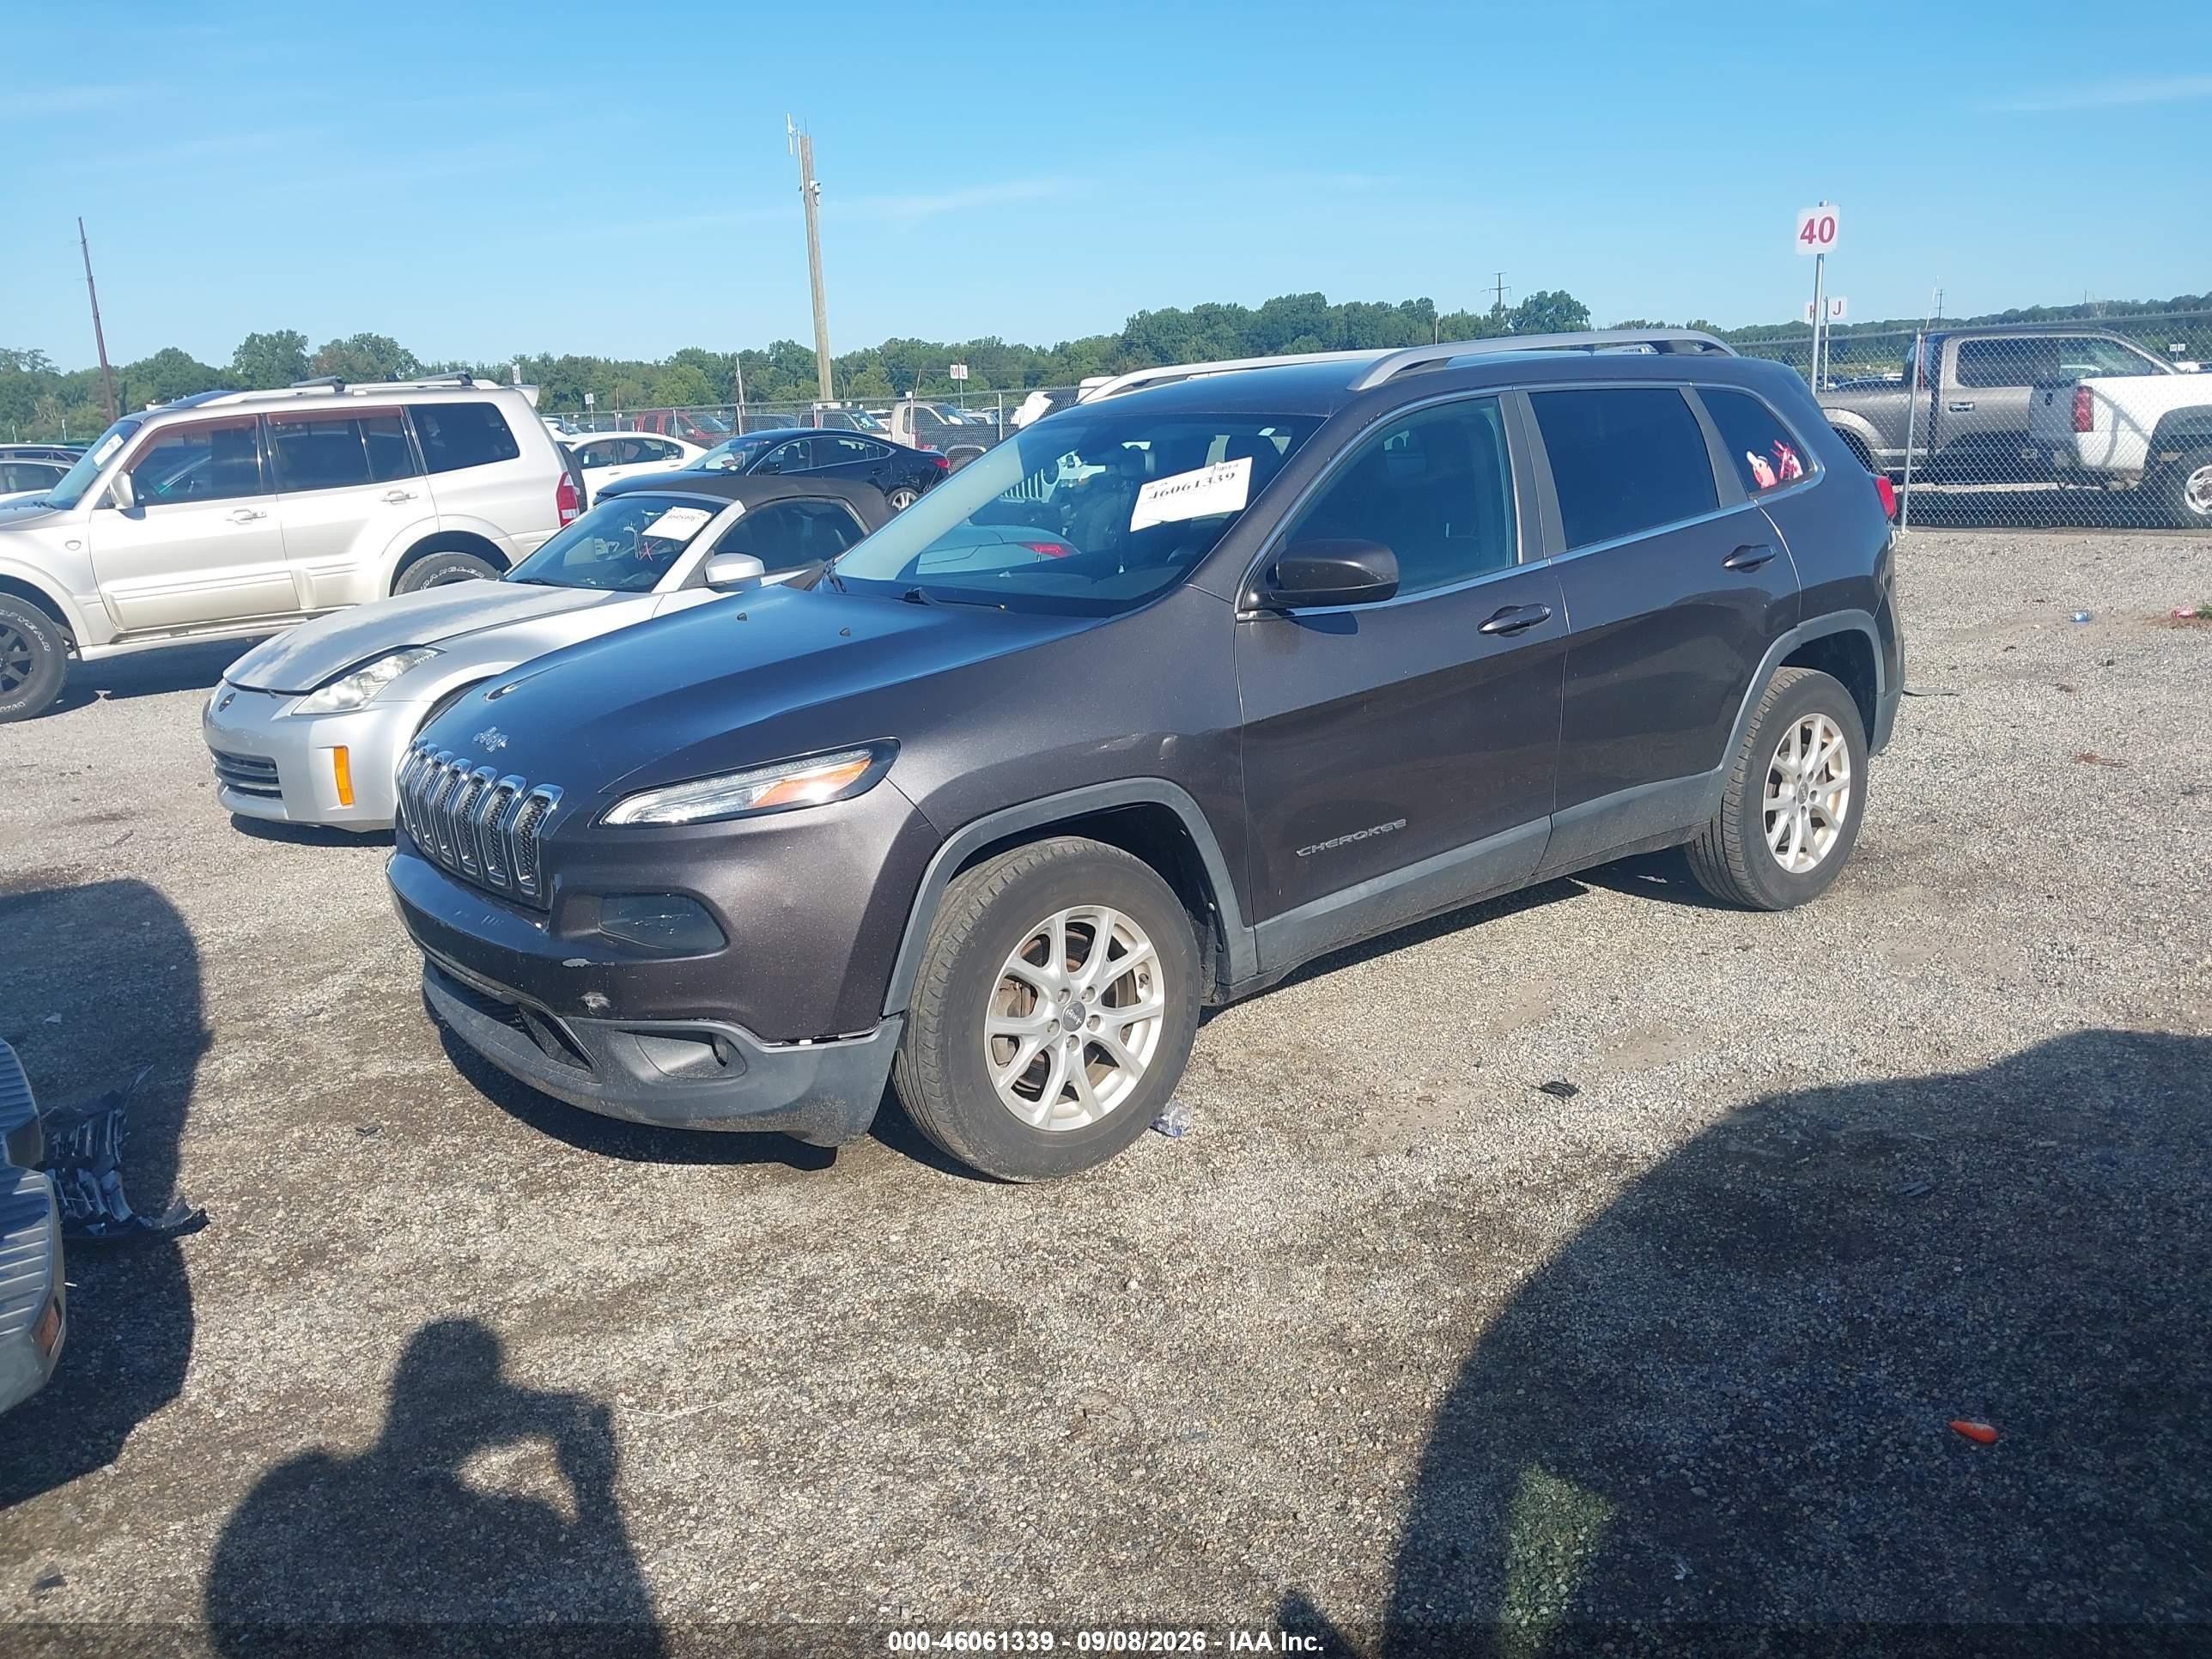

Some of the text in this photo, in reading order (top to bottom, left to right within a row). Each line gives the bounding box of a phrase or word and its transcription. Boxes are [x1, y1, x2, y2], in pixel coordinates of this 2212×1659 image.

[1800, 216, 1836, 245] 40
[1832, 301, 1842, 316] J
[1296, 817, 1407, 857] CHEROKEE
